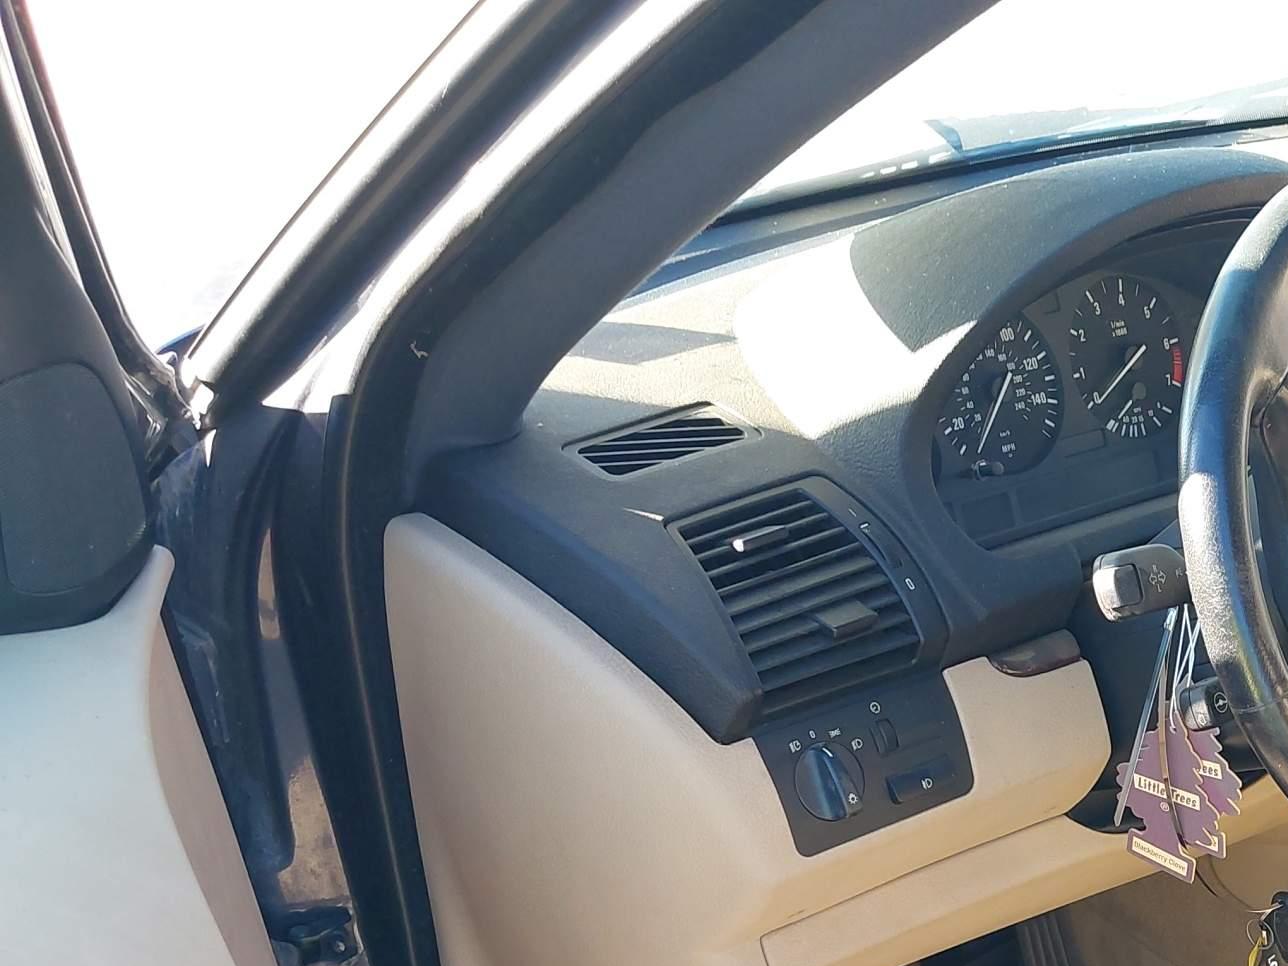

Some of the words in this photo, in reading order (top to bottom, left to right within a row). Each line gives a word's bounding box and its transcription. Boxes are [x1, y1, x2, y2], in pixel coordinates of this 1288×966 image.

[1118, 294, 1125, 306] 4
[1093, 302, 1101, 315] 3
[999, 327, 1015, 342] 100
[1078, 329, 1086, 342] 2
[1023, 358, 1039, 371] 120
[1031, 391, 1047, 406] 140
[952, 417, 965, 430] 20
[1138, 777, 1166, 796] Little
[1171, 788, 1197, 807] Trees
